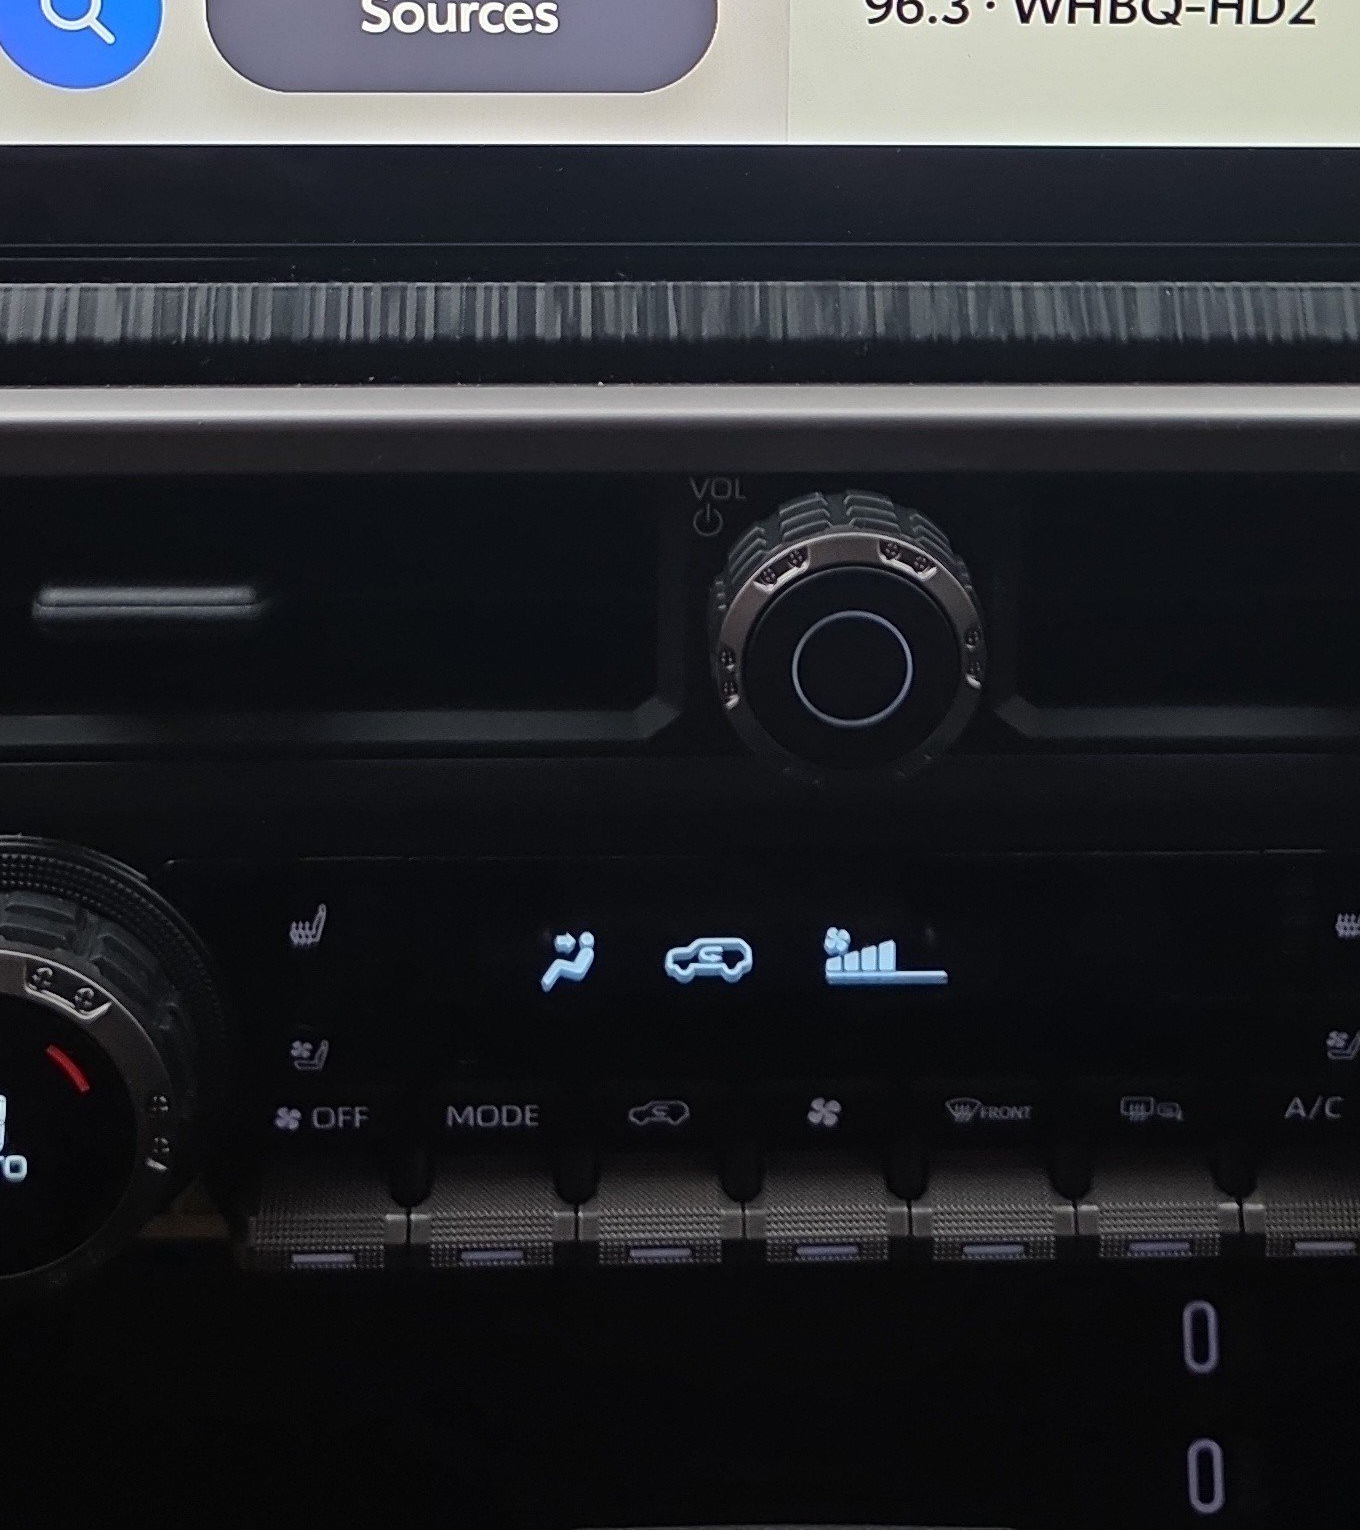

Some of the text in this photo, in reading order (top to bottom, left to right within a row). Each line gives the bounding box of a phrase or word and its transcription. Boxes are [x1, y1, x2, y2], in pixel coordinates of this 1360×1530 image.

[690, 479, 745, 500] VOL
[312, 1107, 366, 1128] OFF
[447, 1105, 537, 1126] MODE
[980, 1106, 1032, 1120] FRONT
[1285, 1097, 1341, 1118] A/C
